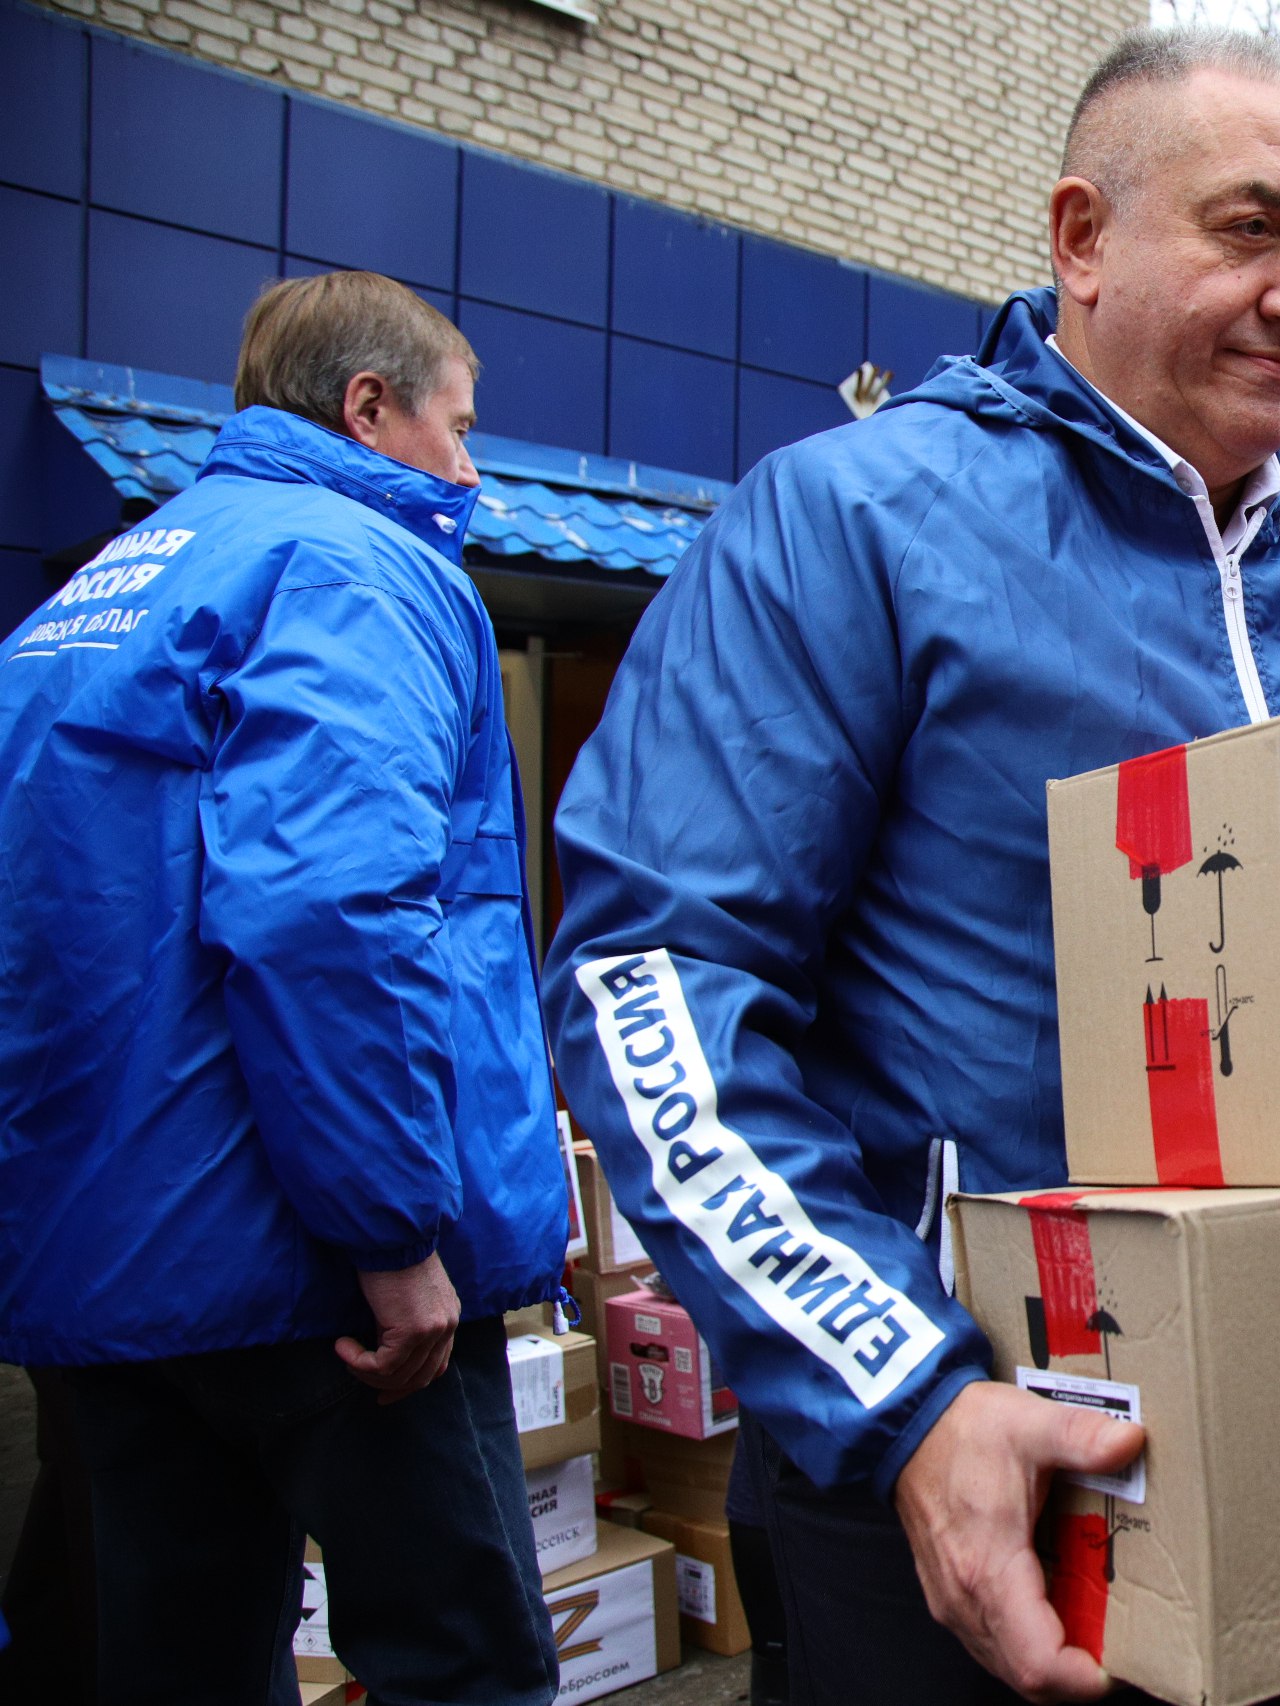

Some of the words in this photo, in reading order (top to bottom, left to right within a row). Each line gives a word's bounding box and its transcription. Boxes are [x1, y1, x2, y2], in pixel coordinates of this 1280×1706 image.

[47, 563, 166, 610] РОССИЯ
[598, 954, 725, 1184] РОССИЯ
[700, 1174, 912, 1379] ЕДИНАЯ
[531, 1499, 558, 1518] СИЯ
[559, 1661, 630, 1695] еБросаем
